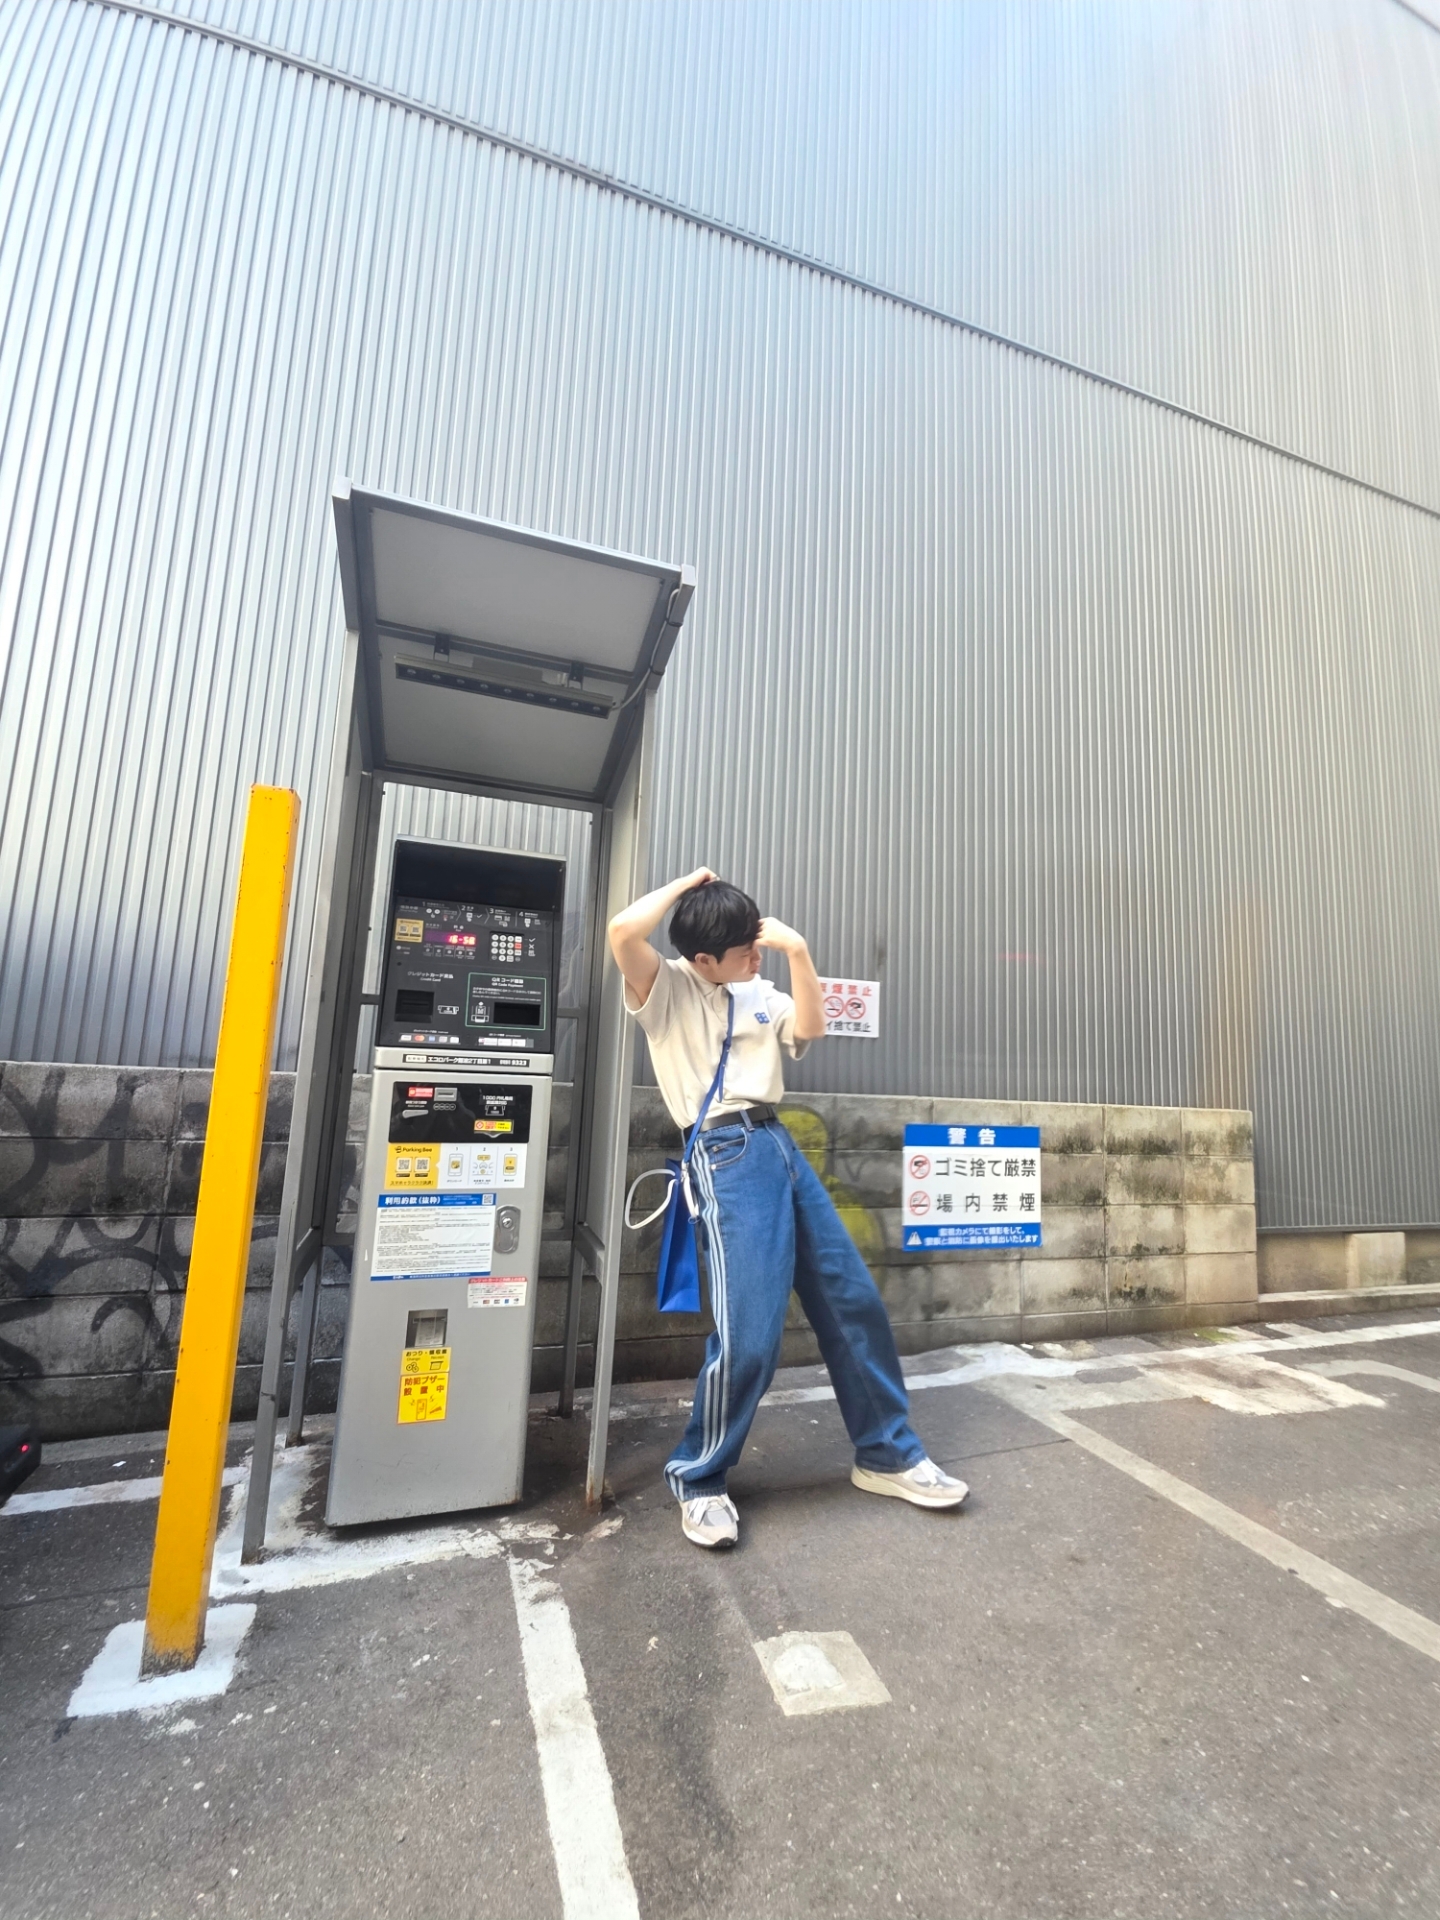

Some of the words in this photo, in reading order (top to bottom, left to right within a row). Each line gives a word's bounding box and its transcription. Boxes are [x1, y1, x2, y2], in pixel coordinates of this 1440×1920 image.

[947, 1127, 996, 1145] 警告
[935, 1158, 1036, 1177] ゴミ捨て厳禁
[936, 1192, 1035, 1213] 場内禁煙
